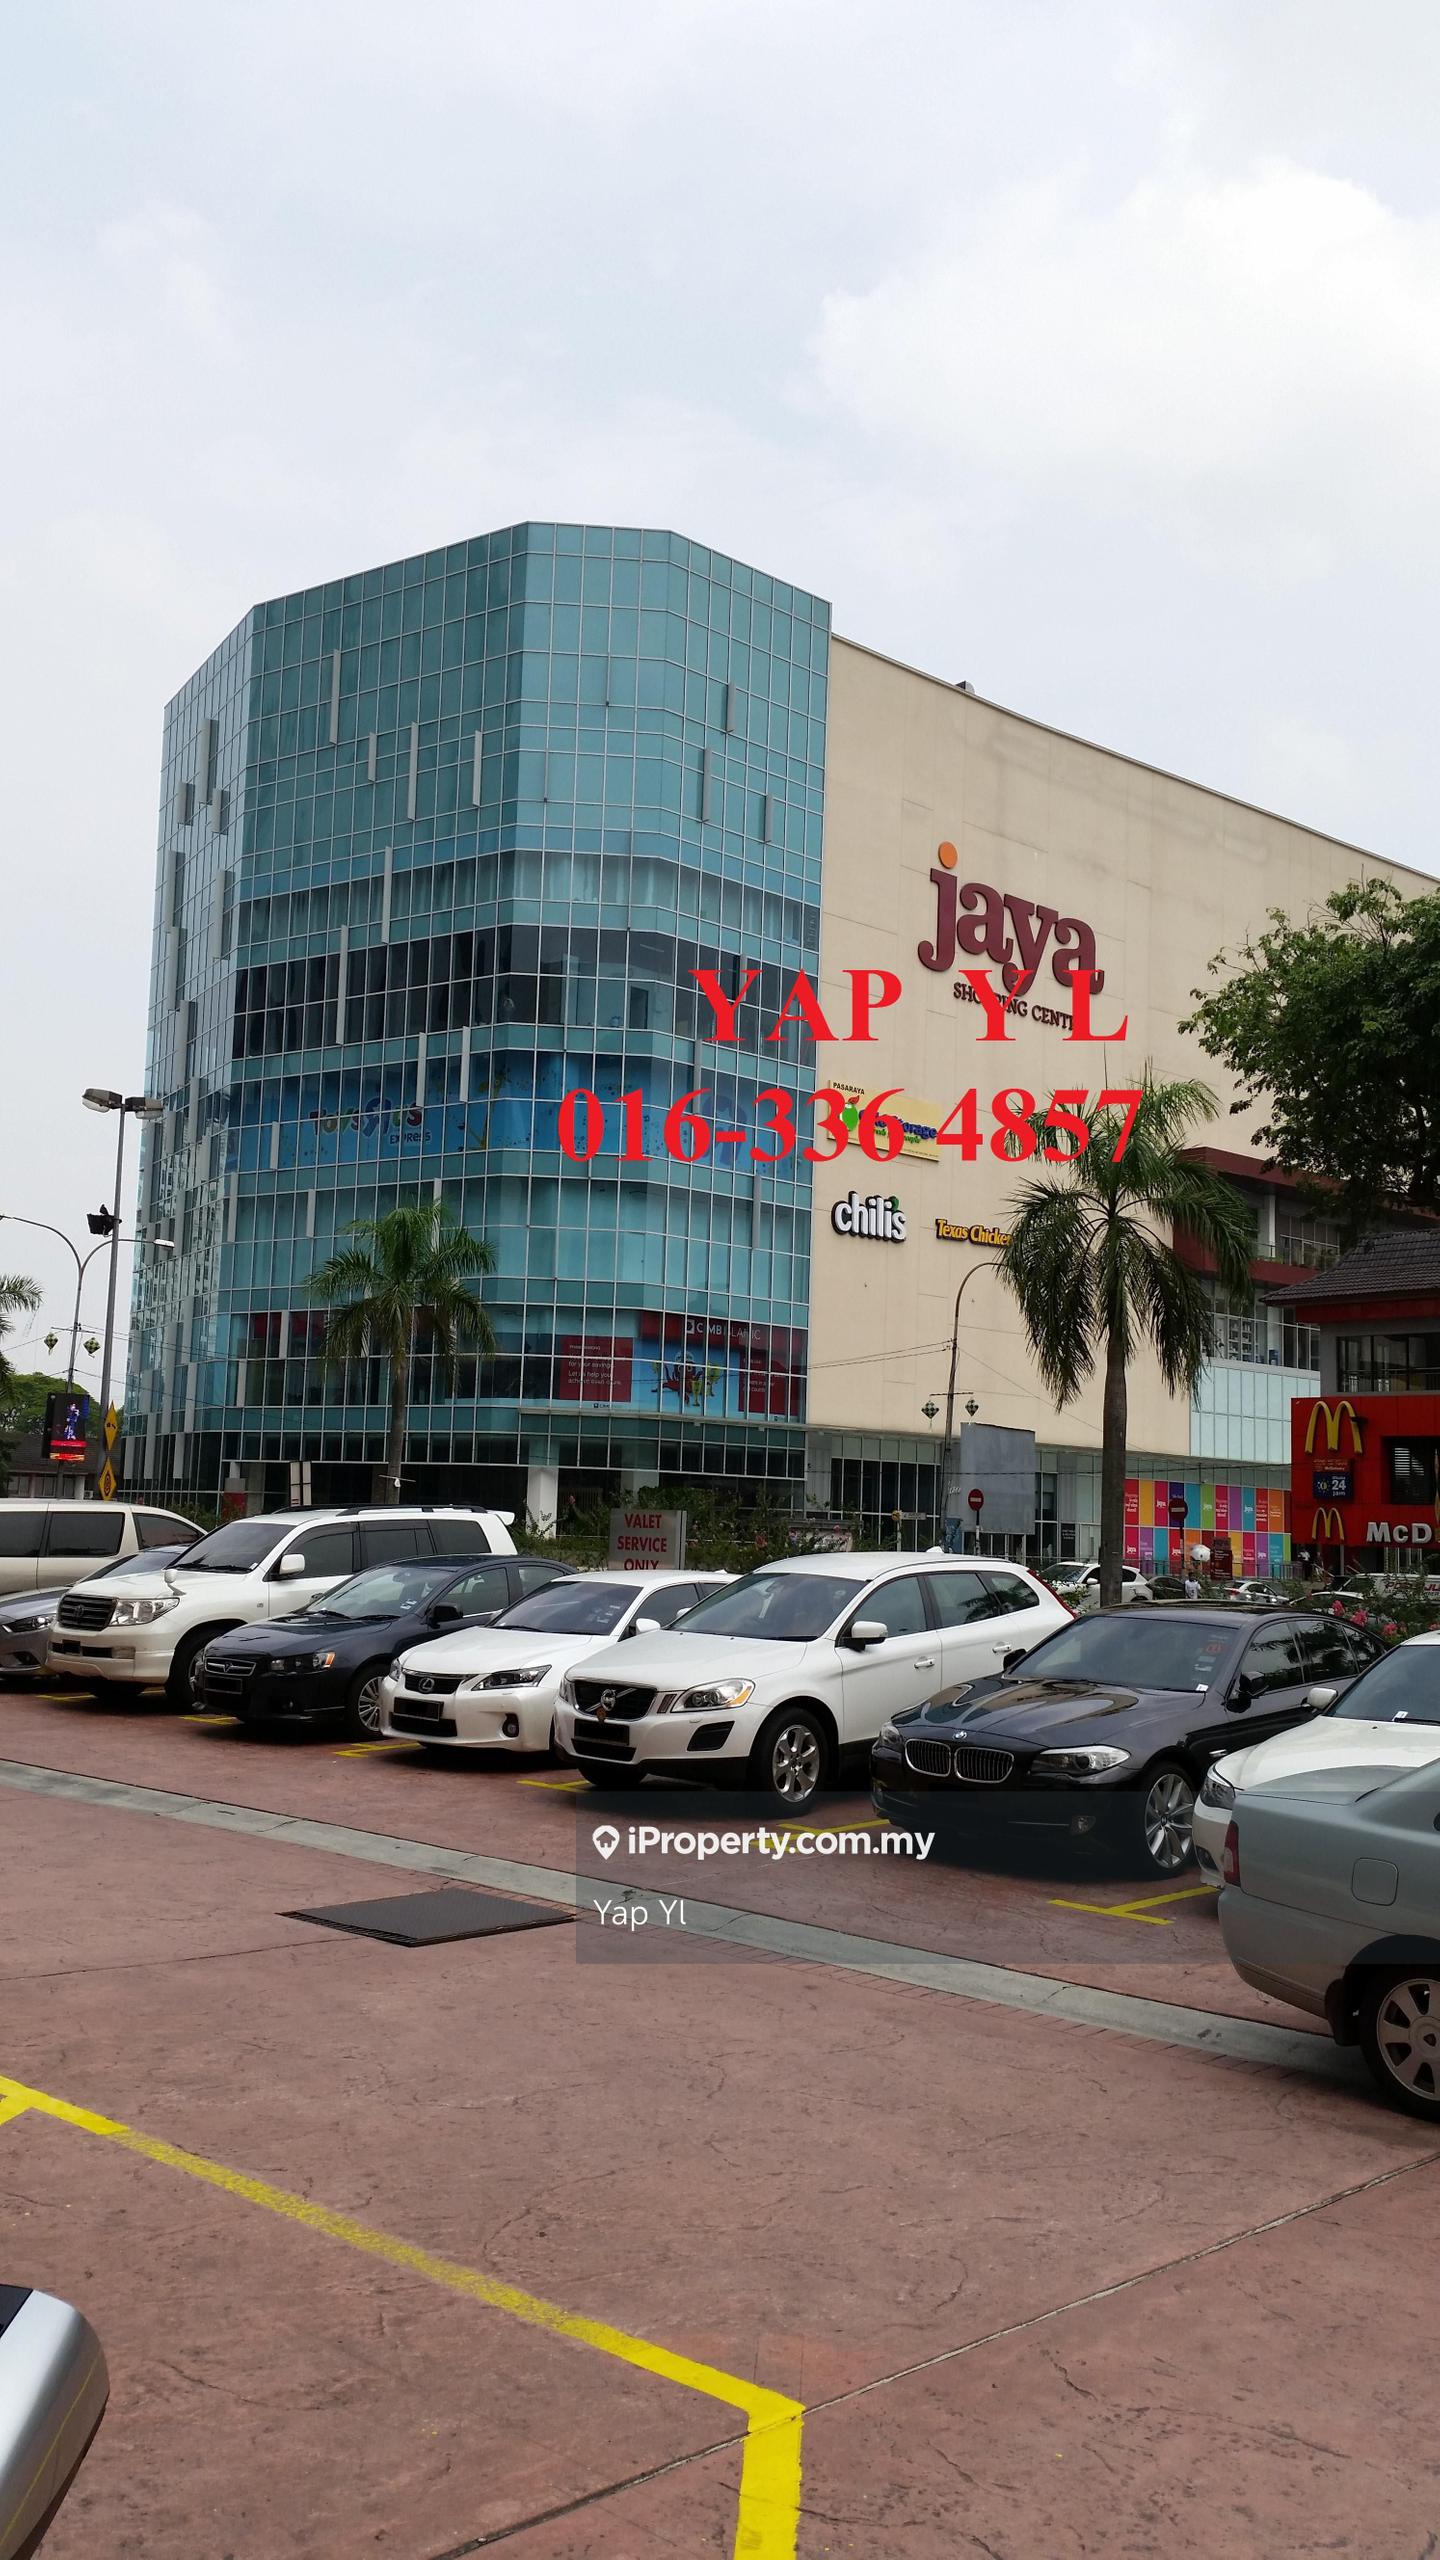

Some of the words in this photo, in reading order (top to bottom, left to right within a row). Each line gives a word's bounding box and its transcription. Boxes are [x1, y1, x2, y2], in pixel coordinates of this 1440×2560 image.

[918, 841, 1104, 996] jaya
[832, 1082, 865, 1096] PASARAYA
[936, 1218, 969, 1240] Texas
[1331, 1479, 1347, 1491] 24
[624, 1513, 662, 1529] VALET
[617, 1535, 667, 1553] SERVICE
